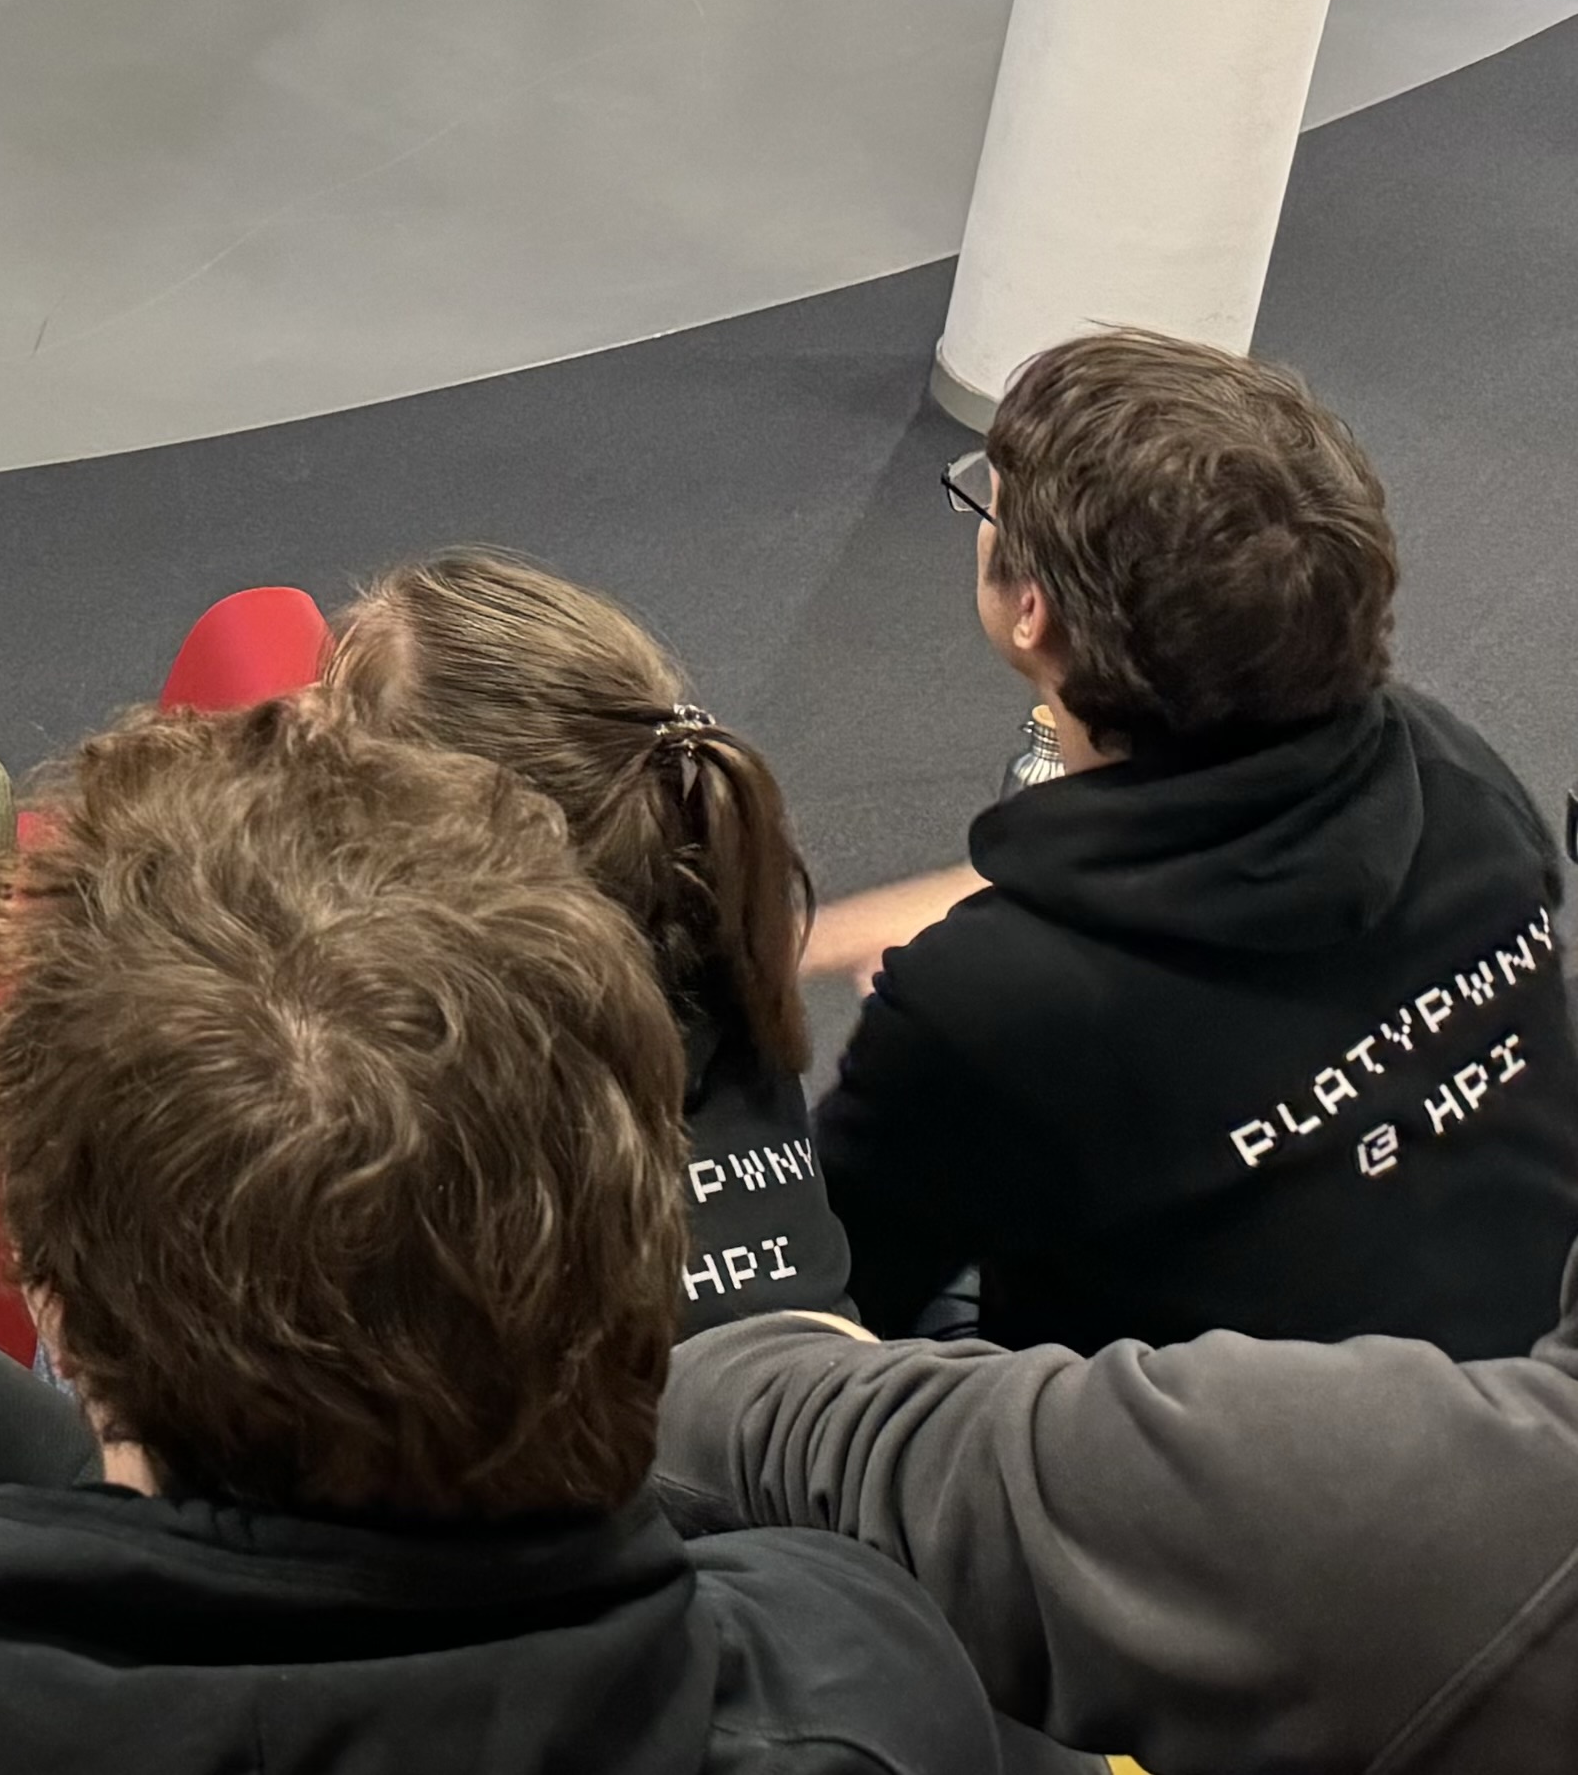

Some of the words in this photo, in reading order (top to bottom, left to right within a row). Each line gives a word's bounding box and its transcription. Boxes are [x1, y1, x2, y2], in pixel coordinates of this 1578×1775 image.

[1229, 906, 1553, 1168] PLATYPWNY
[1357, 1122, 1399, 1176] @
[1424, 1033, 1527, 1135] HPI
[682, 1236, 797, 1300] HPI
